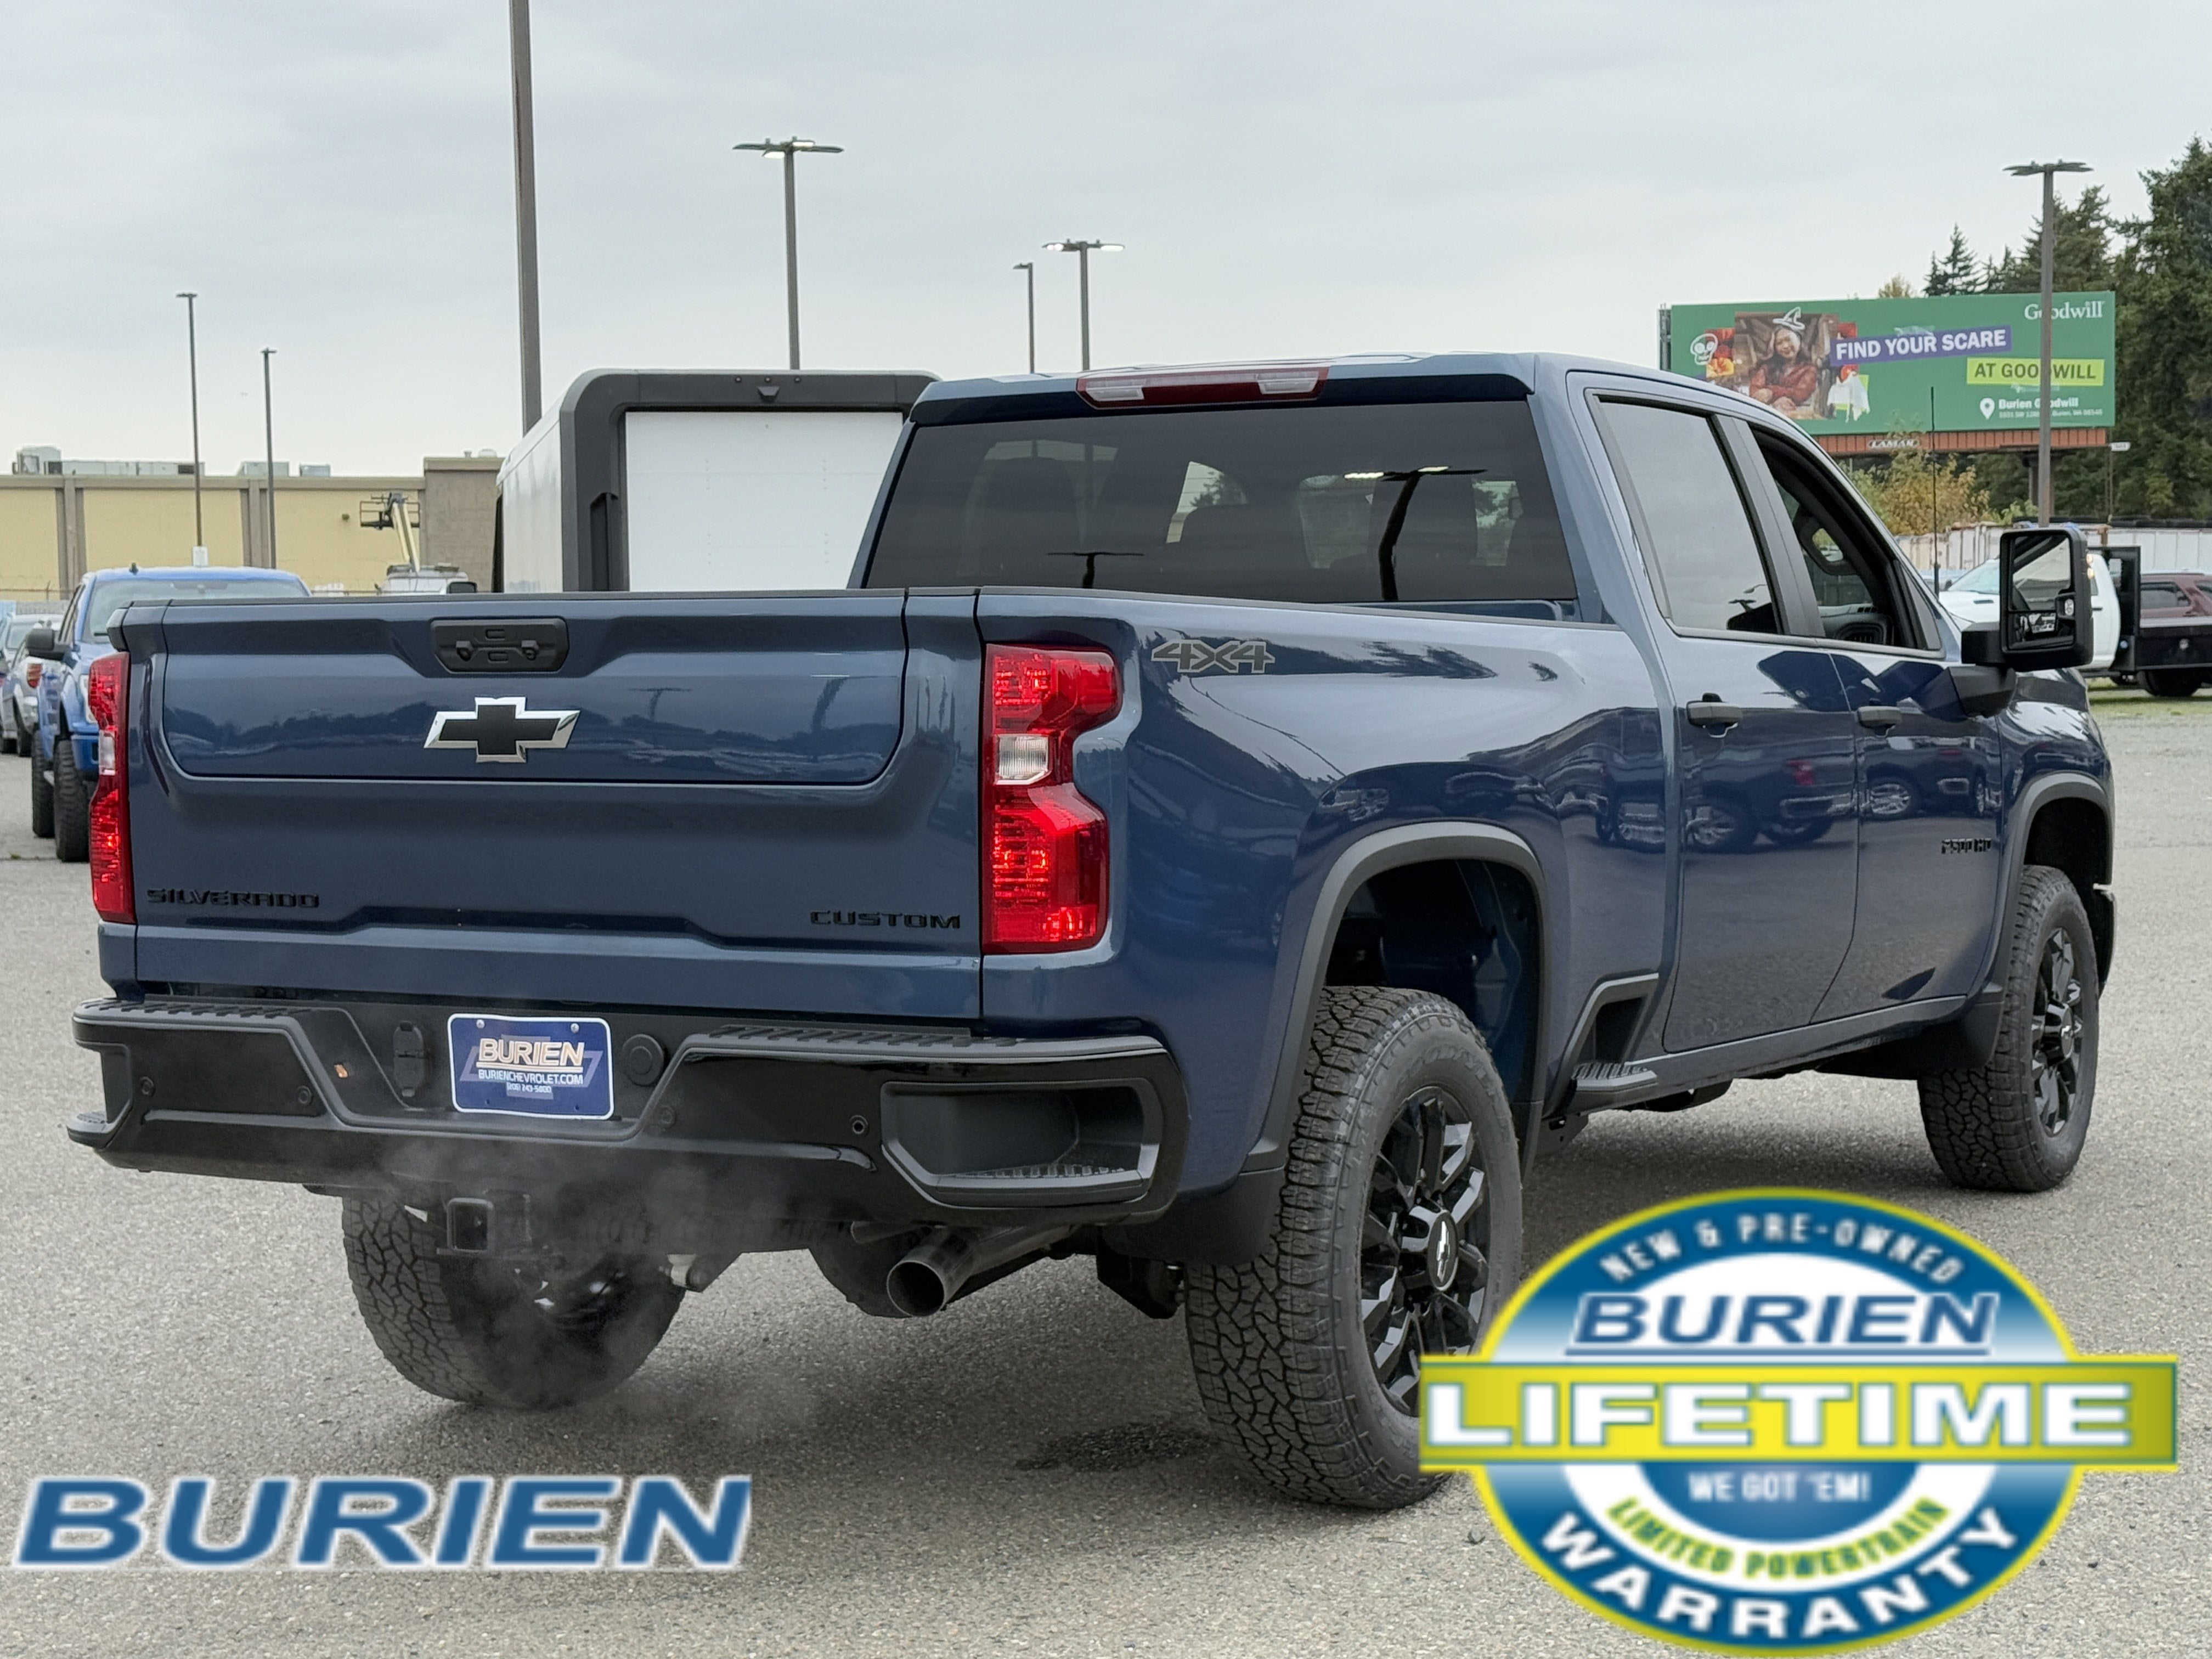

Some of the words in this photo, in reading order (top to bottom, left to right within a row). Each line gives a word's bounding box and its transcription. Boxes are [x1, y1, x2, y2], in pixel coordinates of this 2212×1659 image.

[1836, 340, 1881, 360] FIND
[1884, 335, 1937, 356] YOUR
[1942, 329, 2007, 351] SCARE
[1974, 363, 1996, 378] AT
[2001, 363, 2096, 379] GOOWILL
[146, 888, 320, 909] SILVERADO
[810, 910, 961, 929] CUSTOM
[478, 1038, 585, 1066] BURIEN
[478, 1069, 584, 1085] BURIENCHEVROLET.COM
